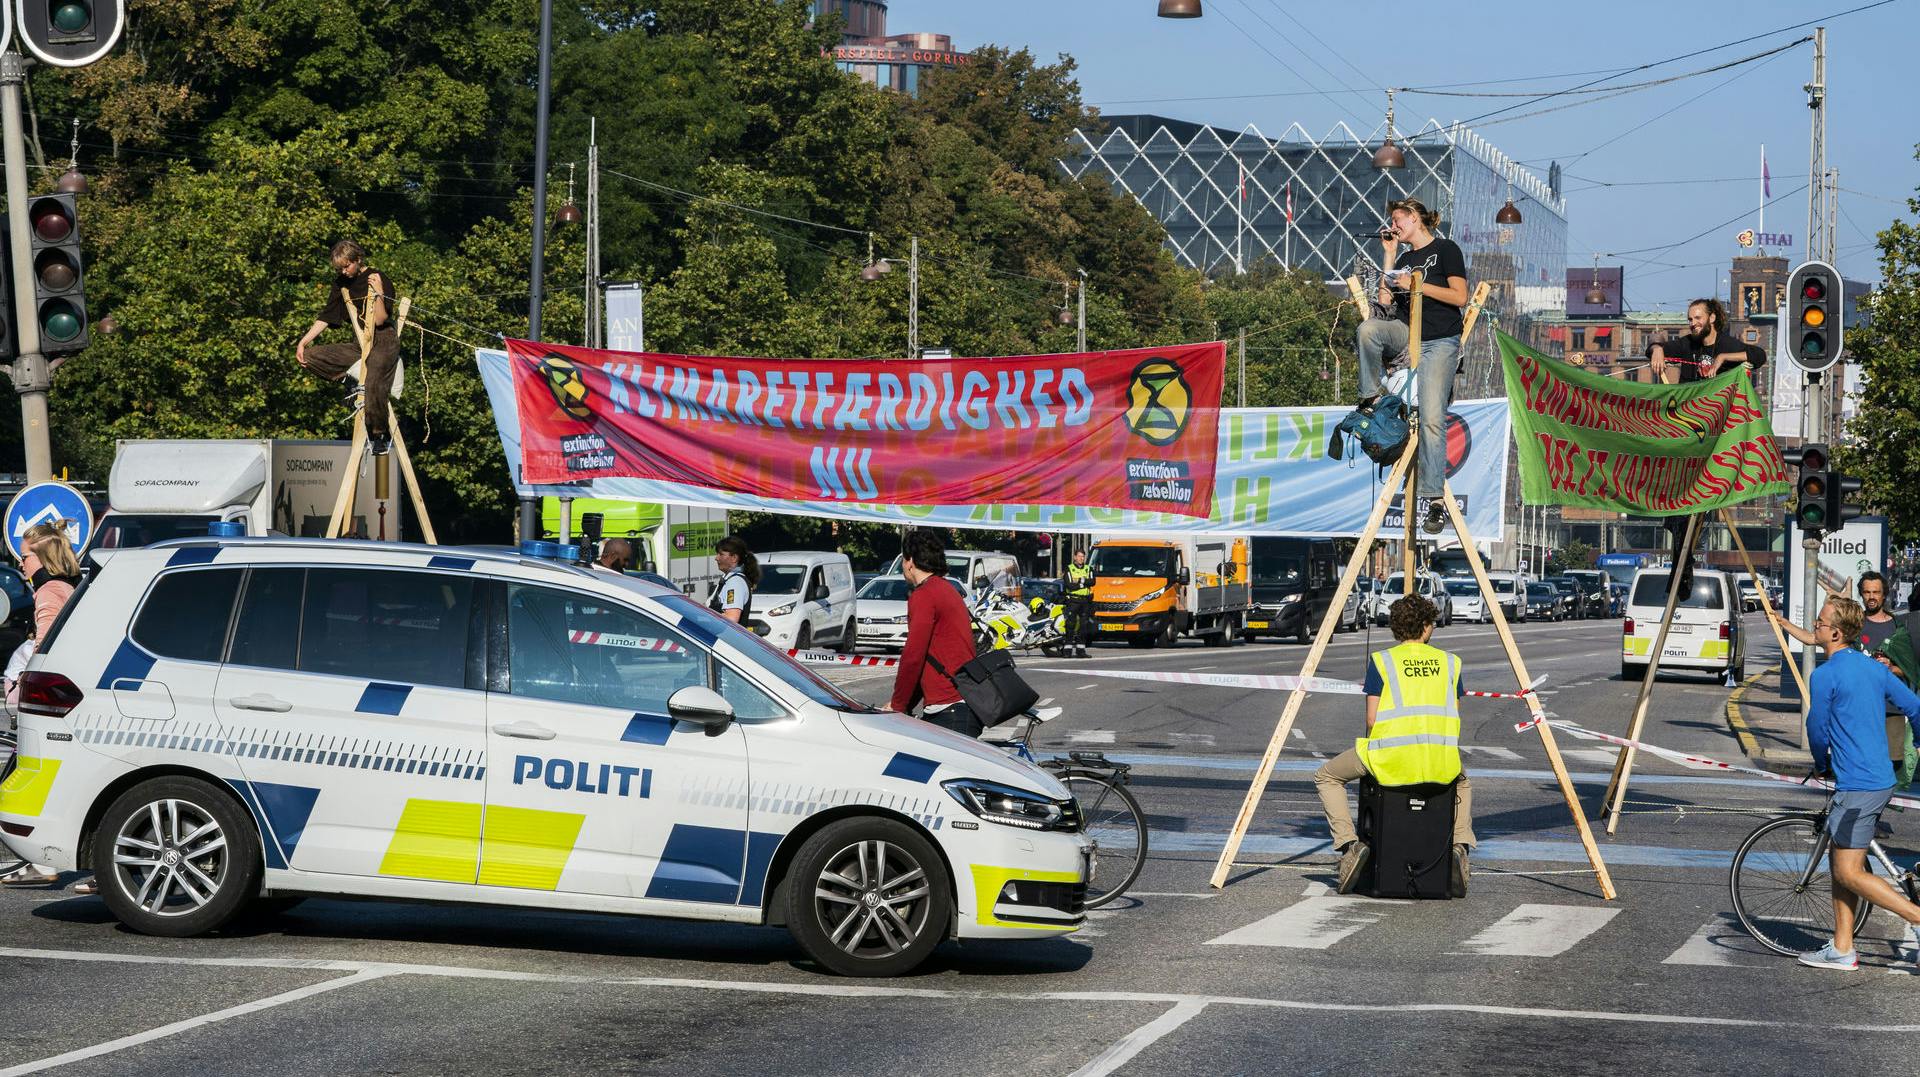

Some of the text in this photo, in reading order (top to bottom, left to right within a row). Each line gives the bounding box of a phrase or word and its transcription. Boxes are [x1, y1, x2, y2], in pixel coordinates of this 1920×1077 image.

[820, 48, 896, 62] RSPIEL
[1756, 233, 1793, 246] THAI
[611, 317, 638, 334] AN
[601, 362, 1094, 430] KLIMARETFÆRDIGHED
[562, 434, 605, 454] extinction
[286, 459, 334, 472] SOFACOMPANY
[1128, 460, 1180, 480] extinction
[809, 447, 878, 500] NU
[134, 479, 200, 487] SOFACOMPANY
[1142, 480, 1192, 501] rebellion
[805, 653, 835, 661] POLITI
[1403, 659, 1440, 667] CLIMATE
[1404, 667, 1441, 678] CREW
[513, 754, 653, 799] POLITI
